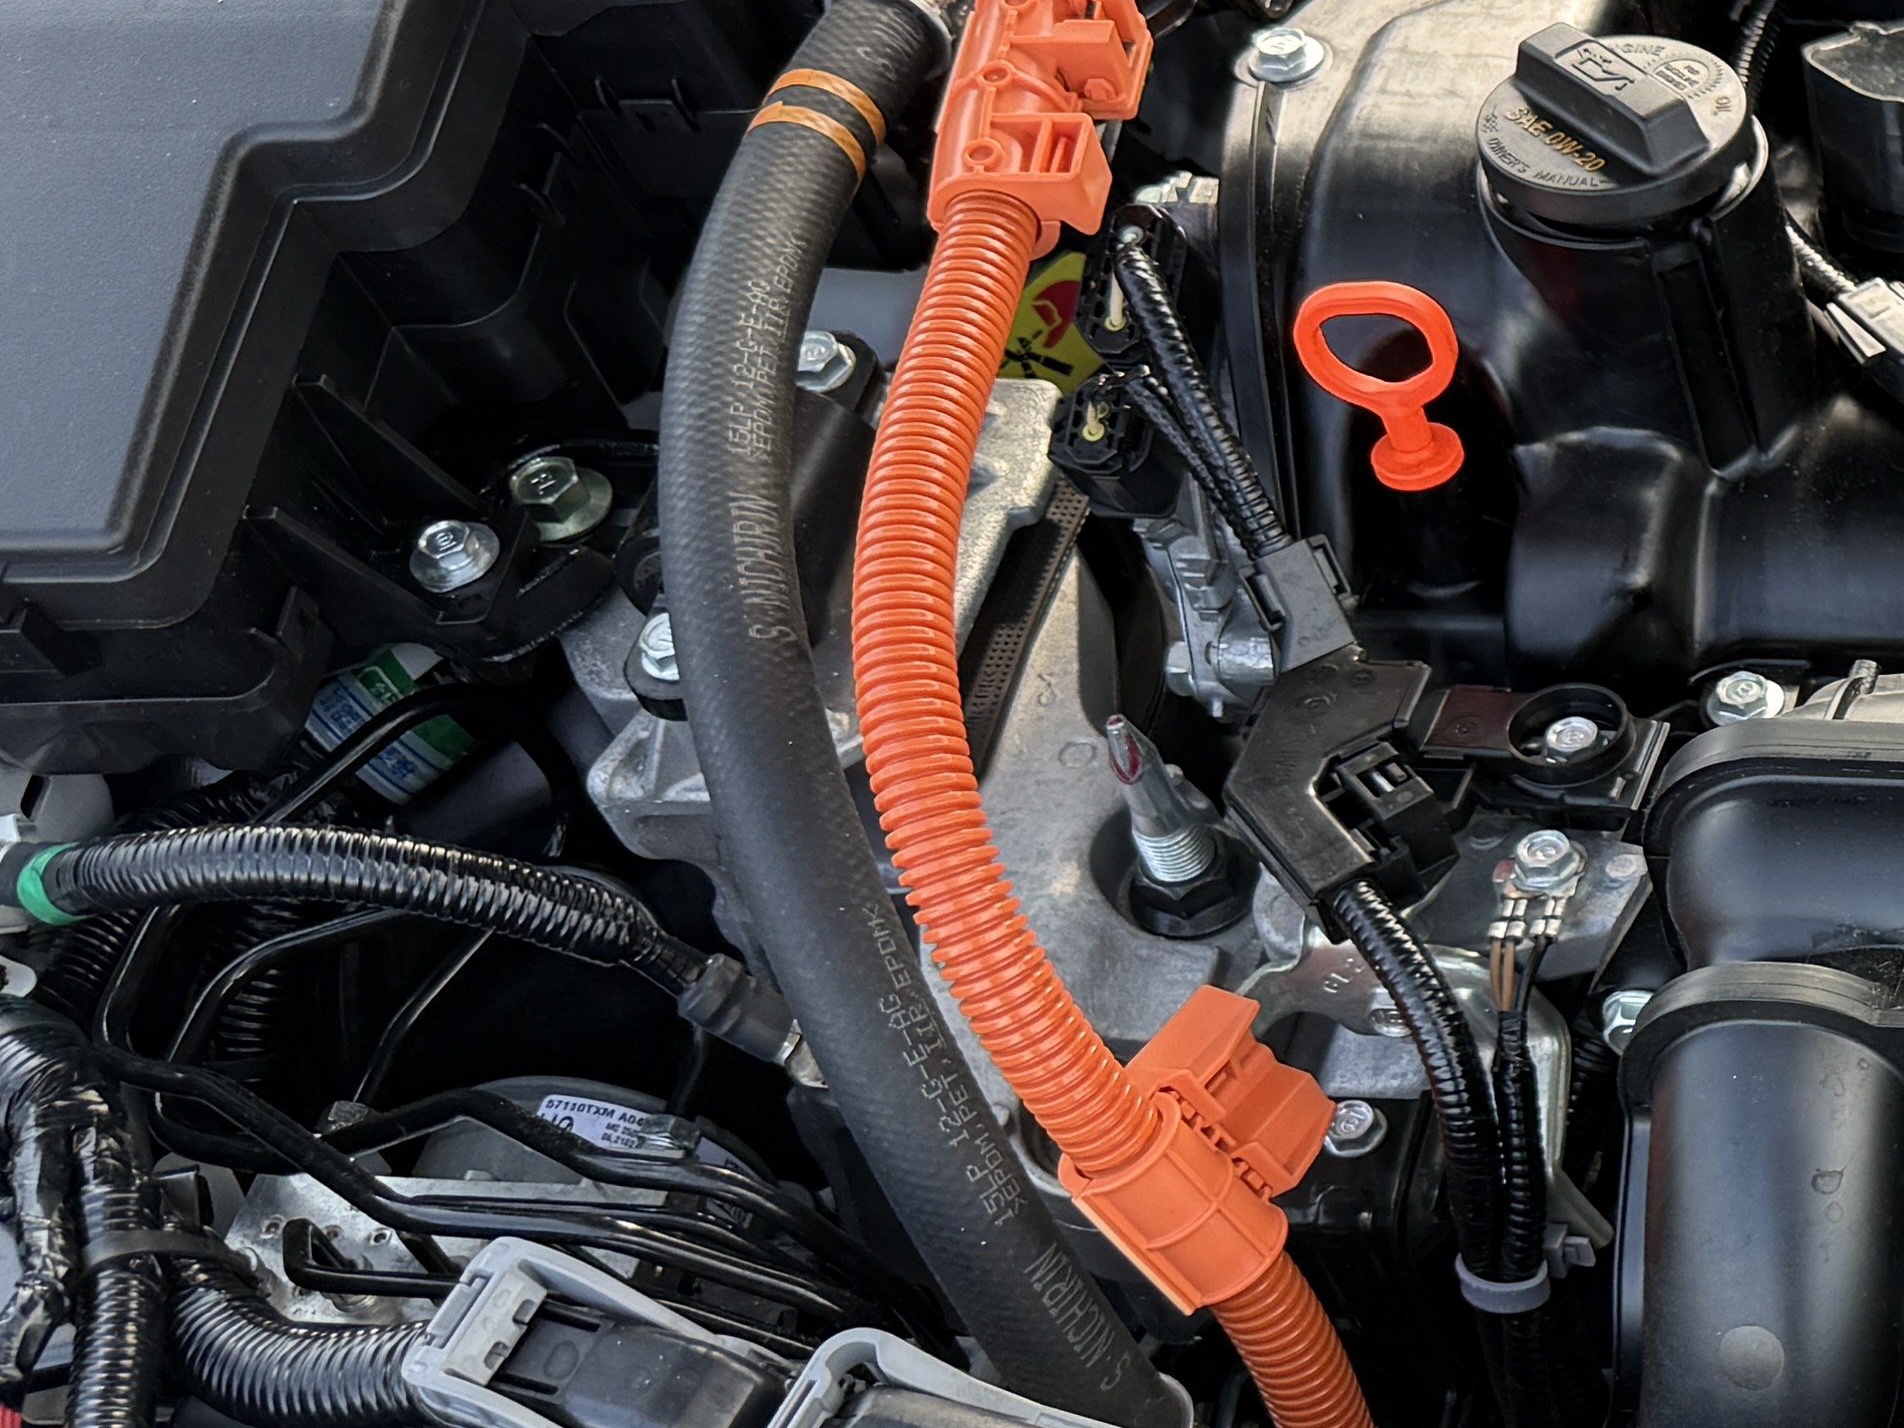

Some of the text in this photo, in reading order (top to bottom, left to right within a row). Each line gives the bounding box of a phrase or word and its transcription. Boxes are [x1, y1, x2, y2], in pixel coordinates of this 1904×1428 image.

[1505, 107, 1553, 138] SAE
[1546, 132, 1606, 173] 0W-20
[1534, 170, 1600, 188] MANUAL
[879, 996, 1015, 1227] 15LP 12-G-E-AG
